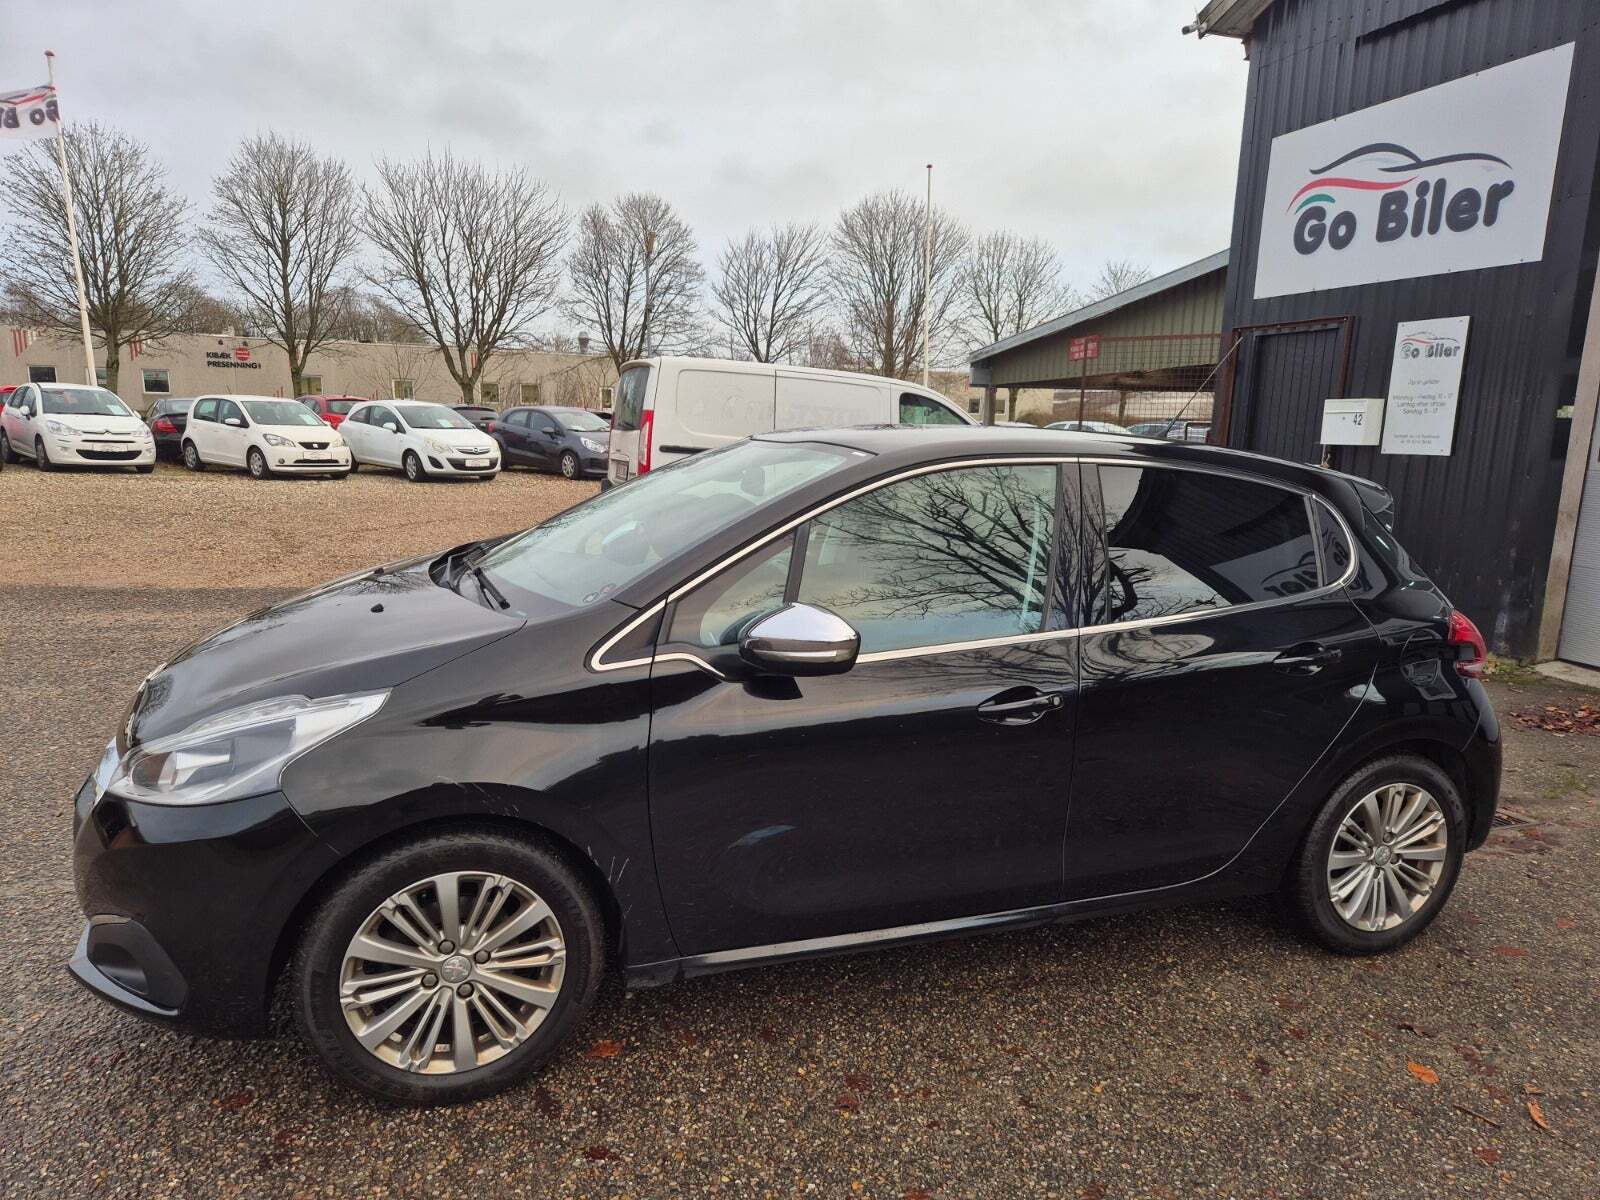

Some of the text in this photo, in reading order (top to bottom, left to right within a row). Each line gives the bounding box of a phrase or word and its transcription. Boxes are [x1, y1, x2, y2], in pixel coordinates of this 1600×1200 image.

[1293, 177, 1515, 255] Go Biler
[207, 360, 257, 369] PRESENNING
[1353, 413, 1363, 426] 42
